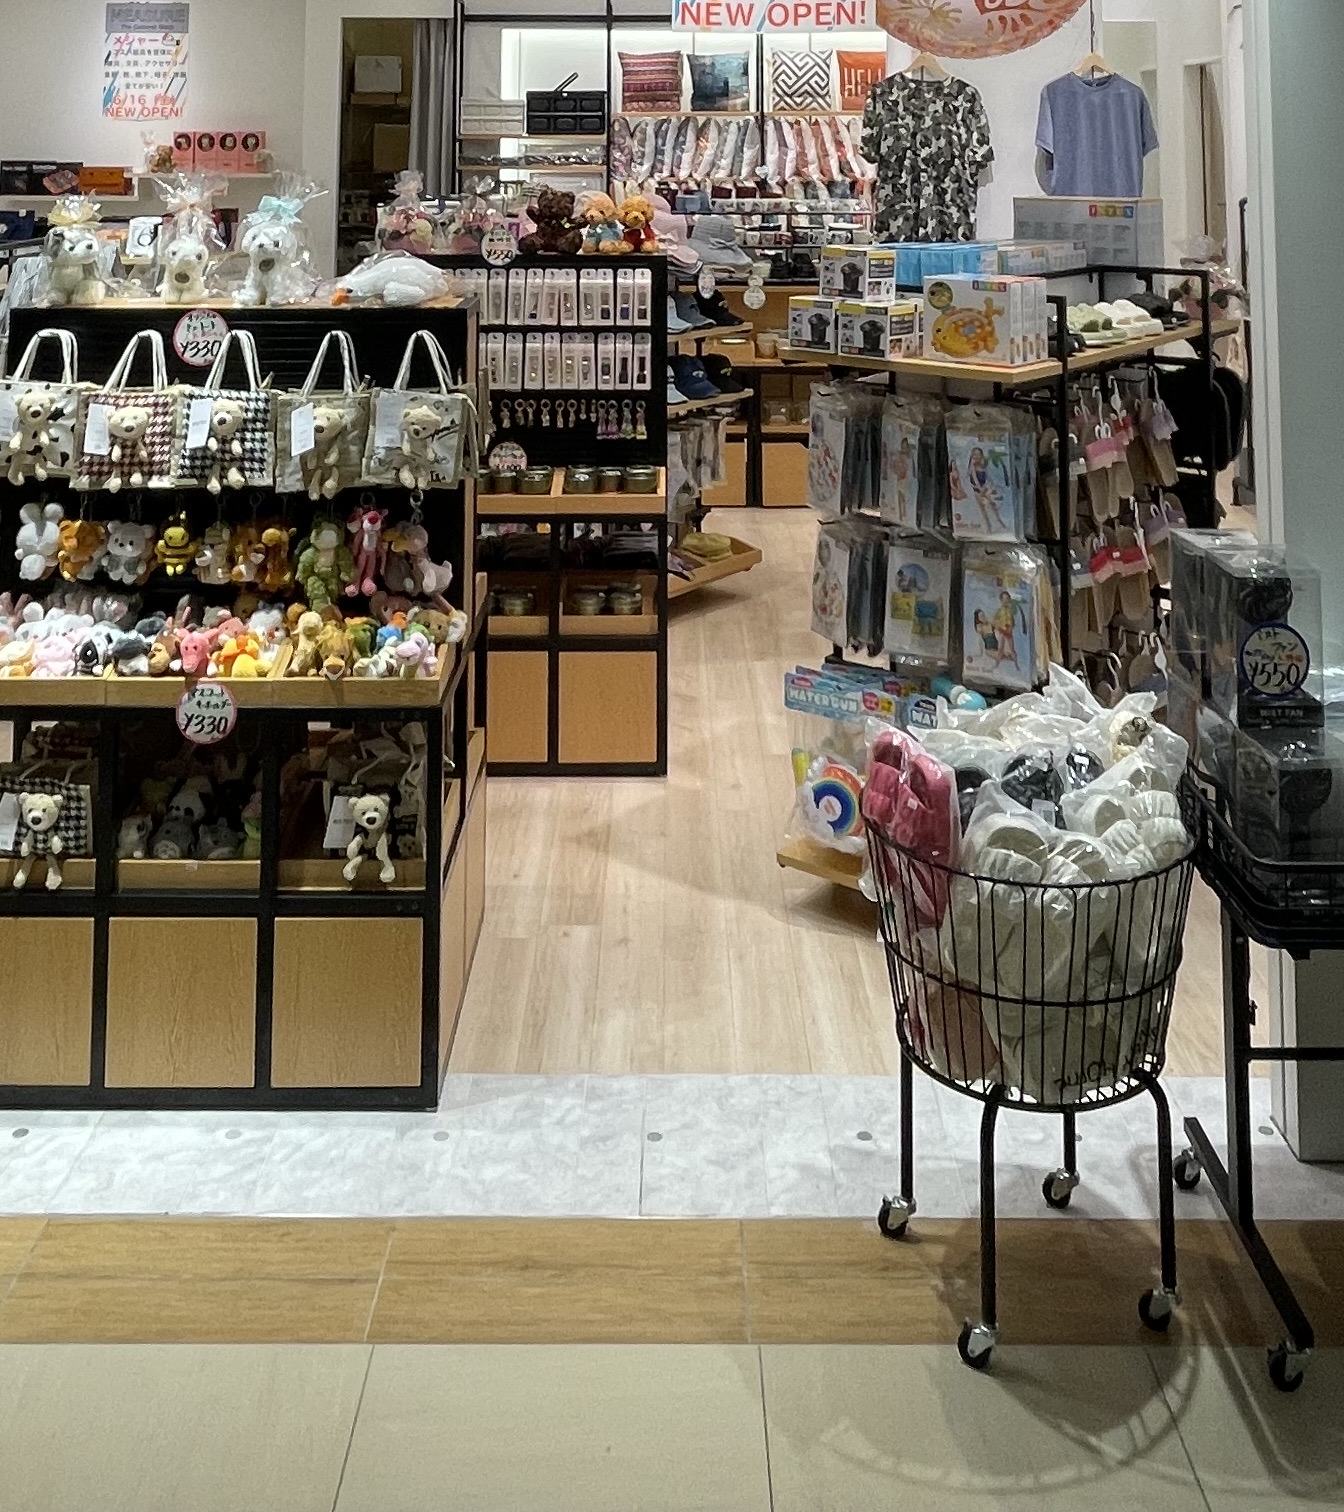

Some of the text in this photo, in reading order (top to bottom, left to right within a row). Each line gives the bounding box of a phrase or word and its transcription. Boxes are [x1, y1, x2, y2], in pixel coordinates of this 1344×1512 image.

[680, 1, 866, 27] NEW OPEN!
[105, 108, 183, 117] NEW OPEN!
[787, 687, 859, 714] WATER GUN
[911, 708, 937, 728] WAT
